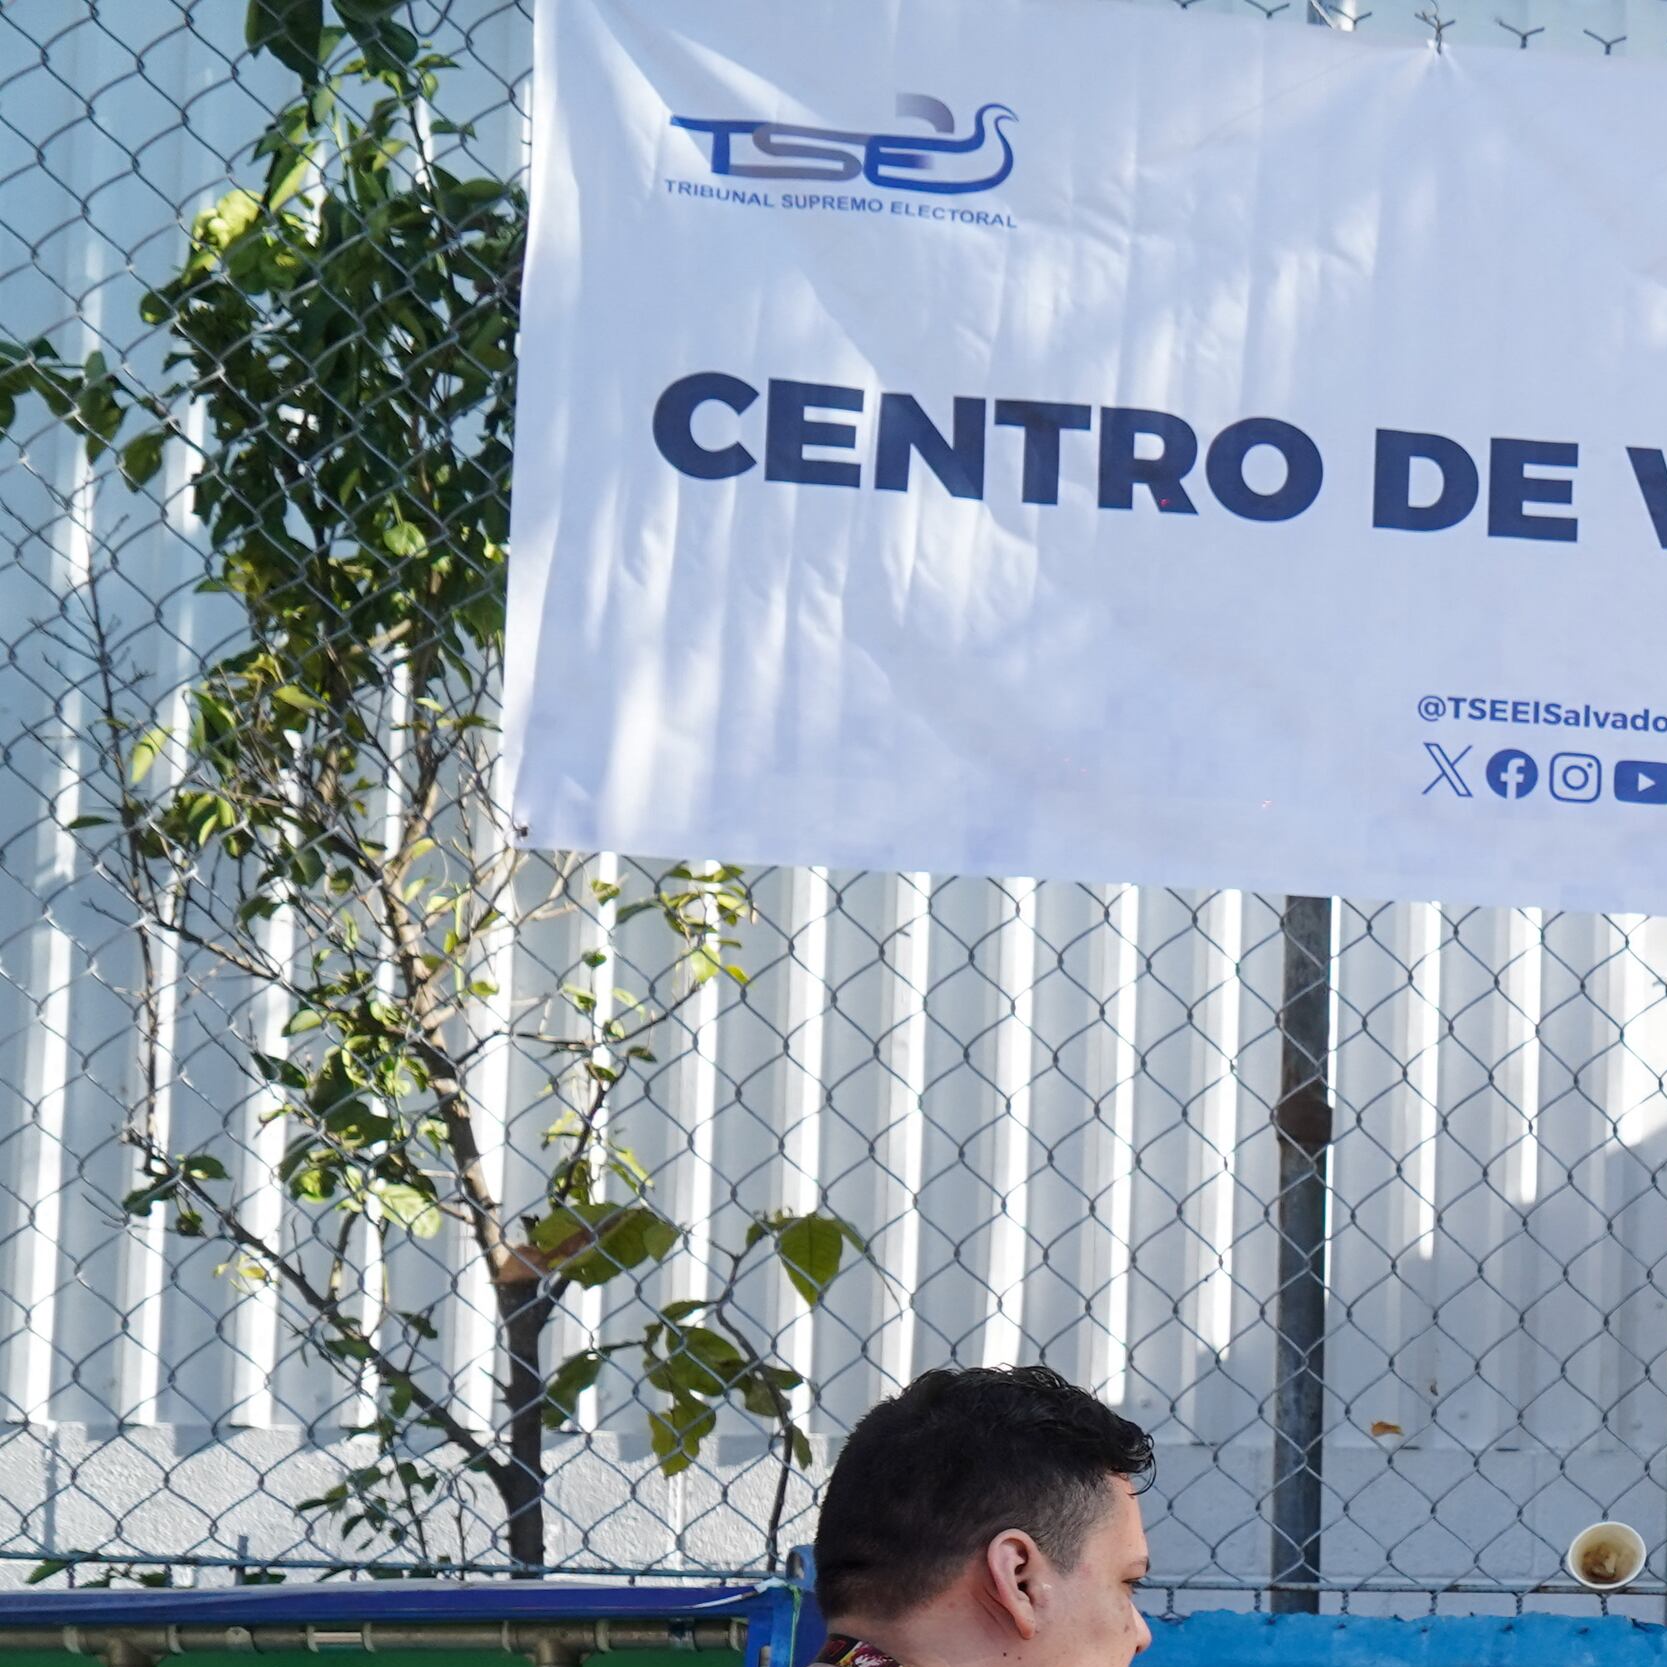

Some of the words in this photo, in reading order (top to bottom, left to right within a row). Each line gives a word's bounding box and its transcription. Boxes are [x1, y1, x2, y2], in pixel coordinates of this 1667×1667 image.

[670, 104, 1019, 195] TSE
[664, 179, 774, 208] TRIBUNAL
[781, 193, 883, 214] SUPREMO
[890, 201, 1018, 228] ELECTORAL
[652, 370, 1324, 523] CENTRO
[1372, 427, 1579, 543] DE
